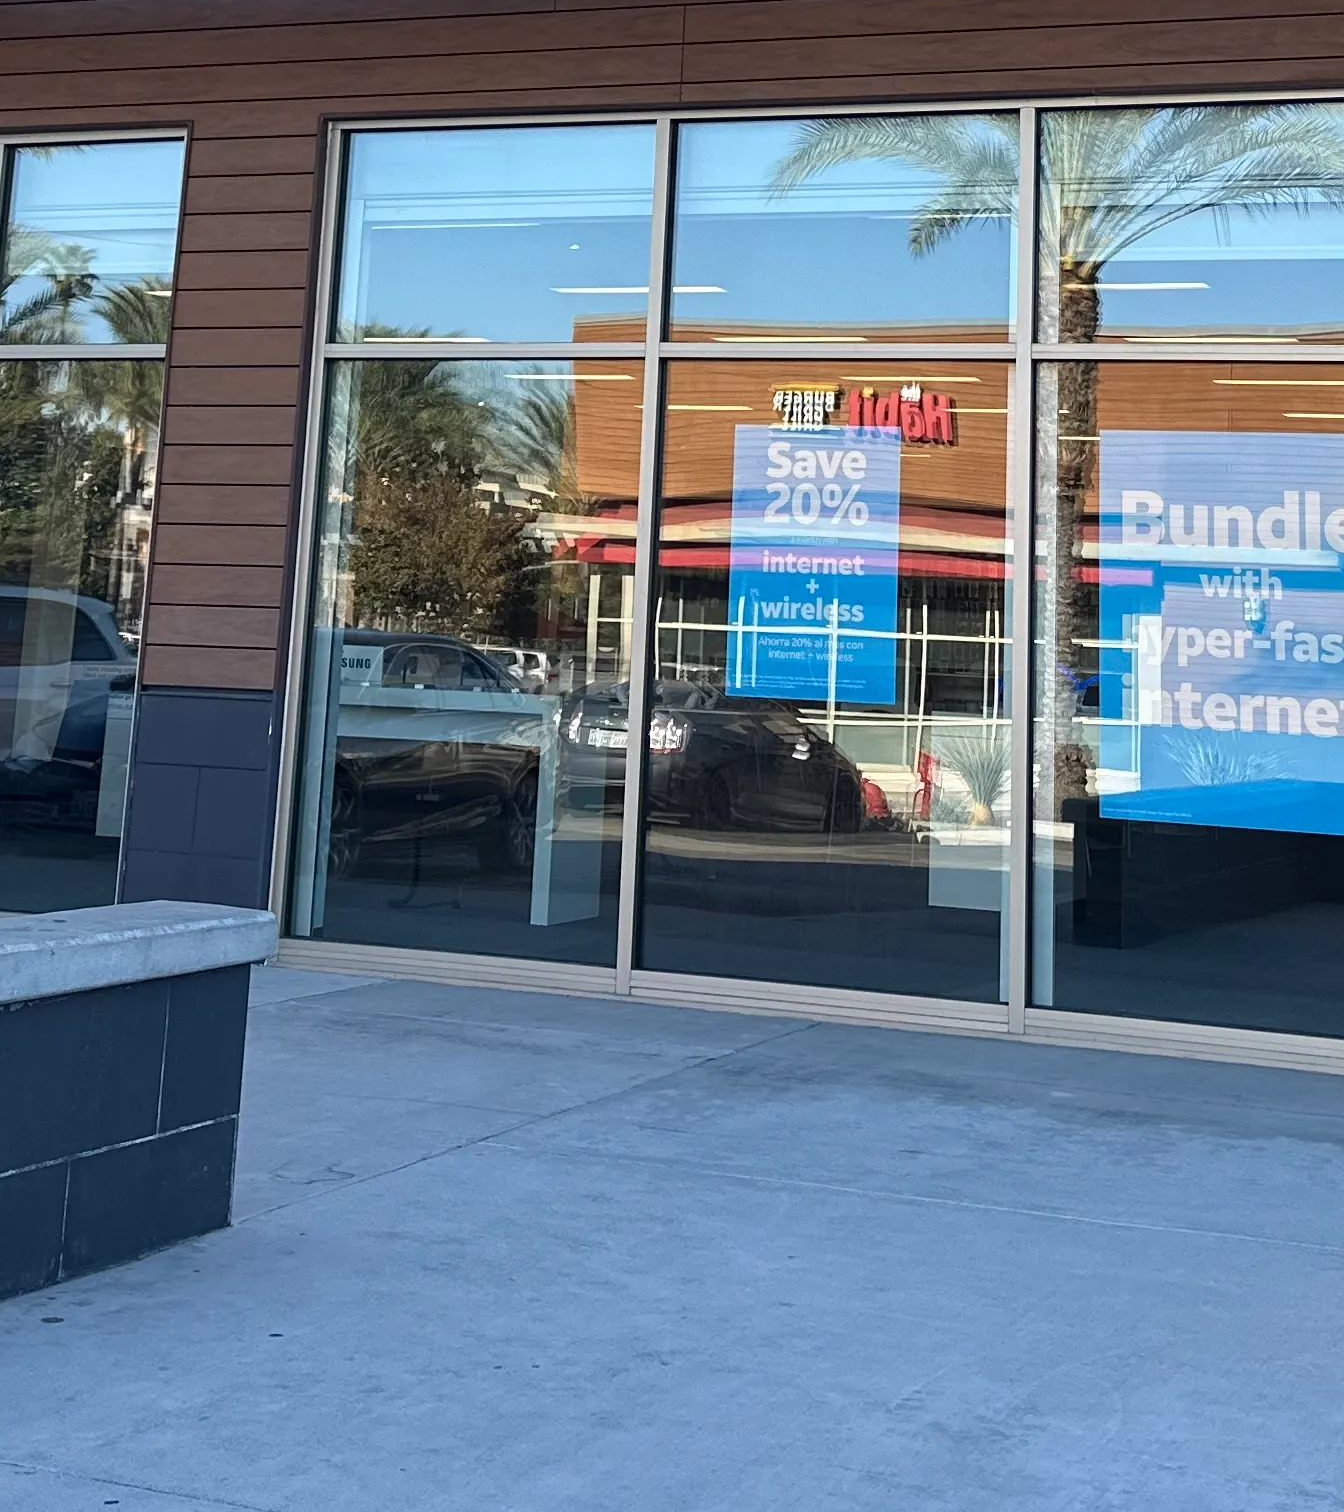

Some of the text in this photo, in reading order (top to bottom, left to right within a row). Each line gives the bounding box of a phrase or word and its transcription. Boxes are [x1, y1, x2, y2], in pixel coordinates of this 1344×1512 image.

[766, 441, 867, 479] Save
[763, 482, 869, 525] 20%
[762, 549, 865, 576] internet
[1199, 567, 1283, 600] with
[761, 596, 864, 622] wireless
[758, 636, 790, 647] Ahorra
[792, 637, 813, 648] 20%
